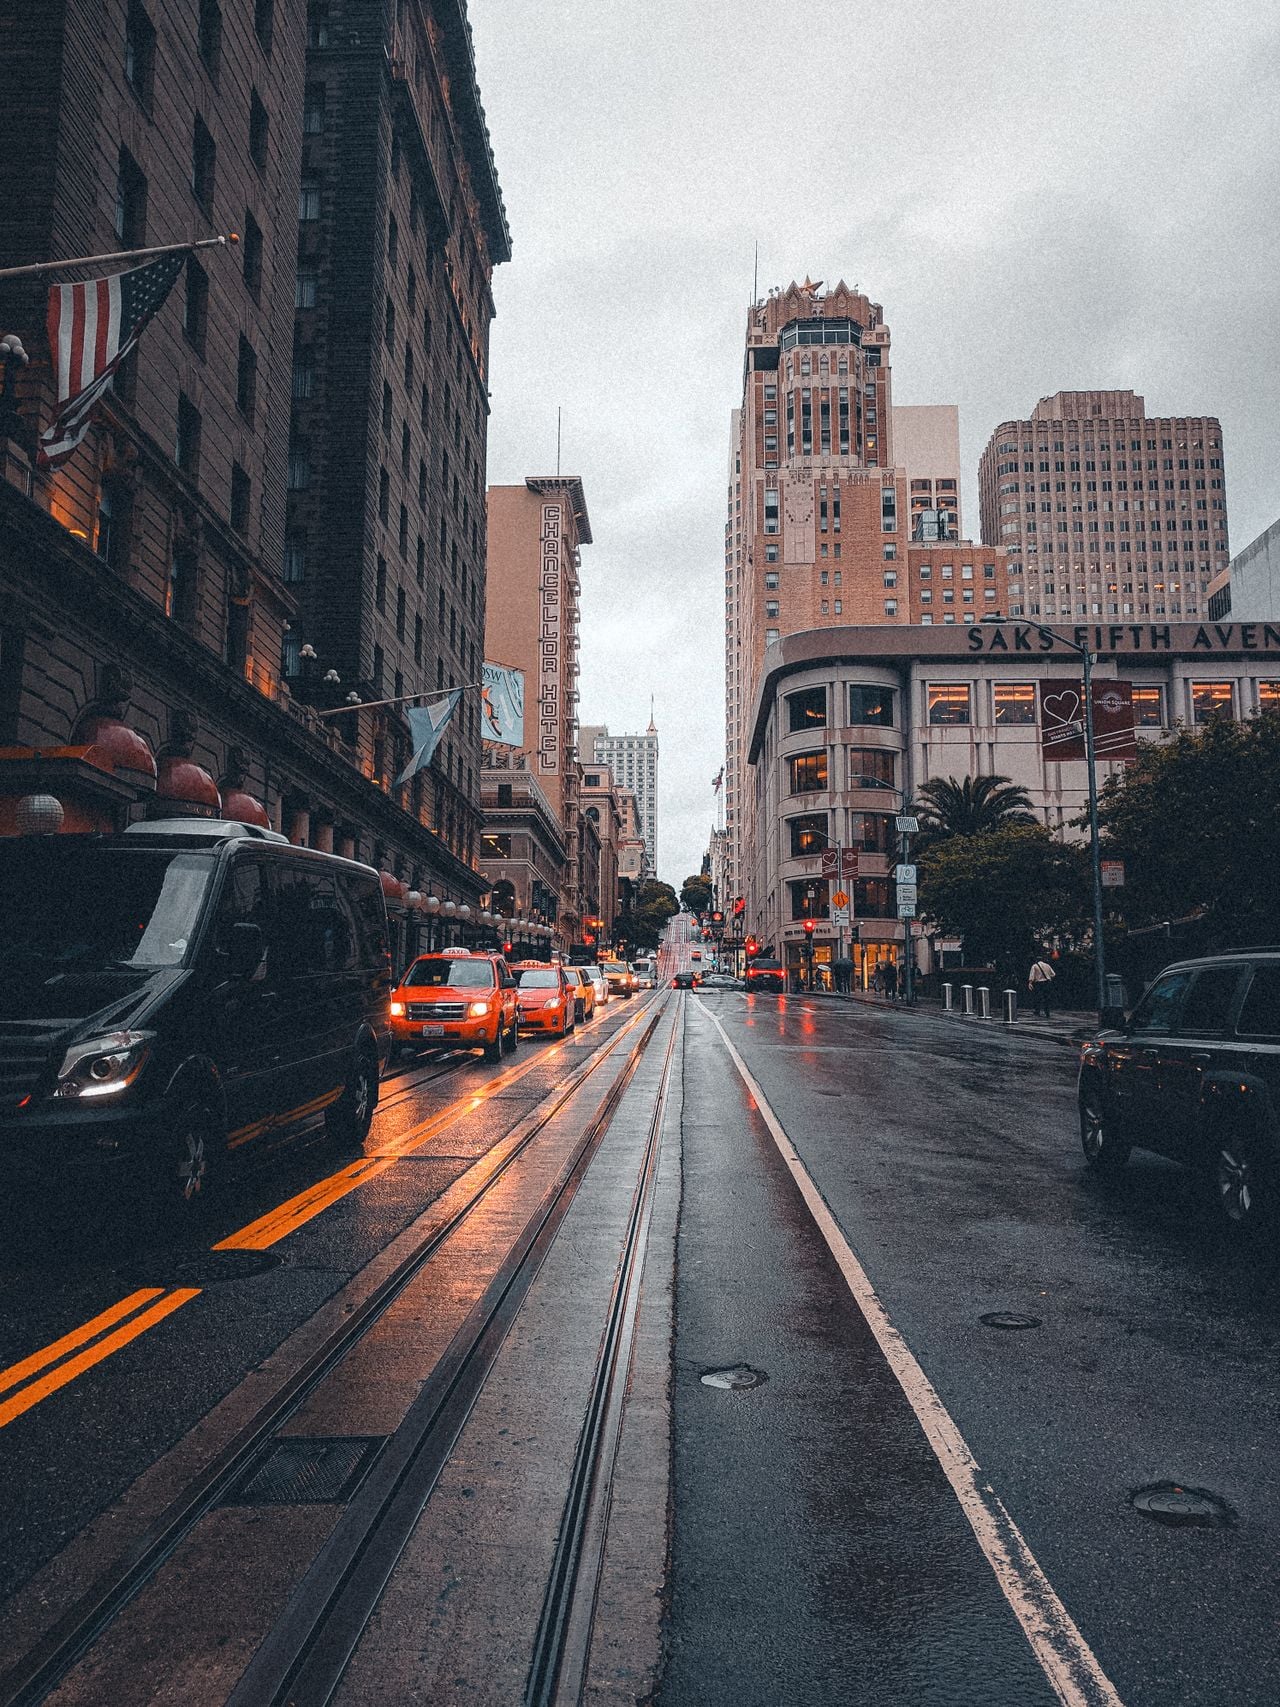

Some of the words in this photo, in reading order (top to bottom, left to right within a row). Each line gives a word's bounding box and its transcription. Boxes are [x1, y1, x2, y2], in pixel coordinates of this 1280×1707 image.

[543, 506, 560, 673] CHANCELLOR
[968, 626, 1054, 651] SAKS
[1074, 626, 1170, 650] FIFTH
[1192, 624, 1280, 649] AVEN
[541, 684, 559, 769] HOTEL
[523, 961, 540, 969] TAXI
